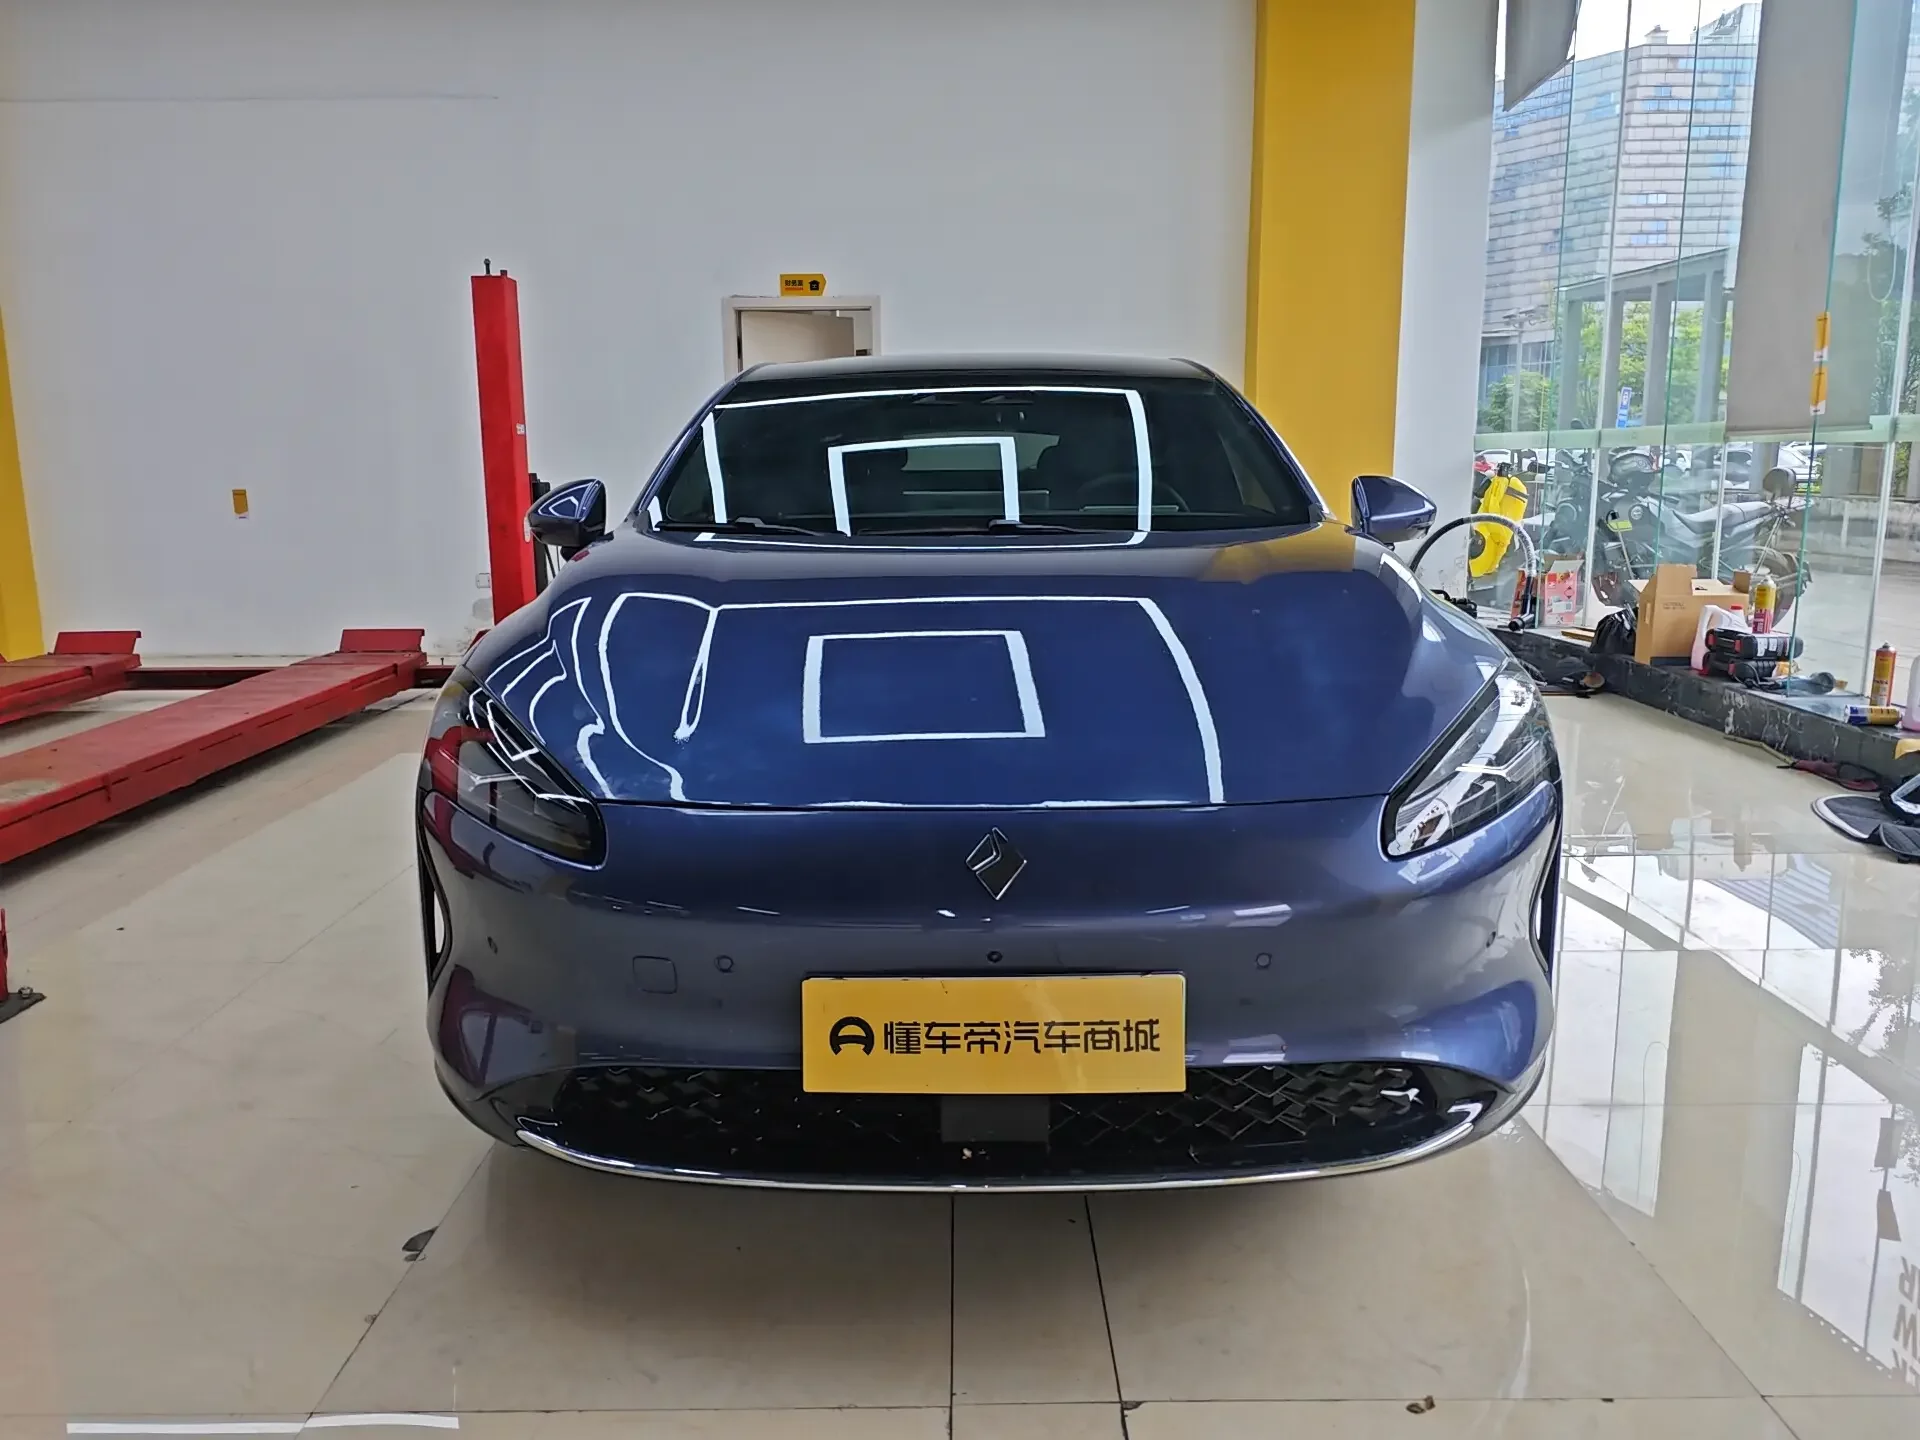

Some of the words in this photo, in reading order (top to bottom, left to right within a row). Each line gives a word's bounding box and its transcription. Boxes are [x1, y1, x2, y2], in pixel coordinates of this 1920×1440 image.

[884, 1018, 1160, 1054] 懂车帝汽车商城
